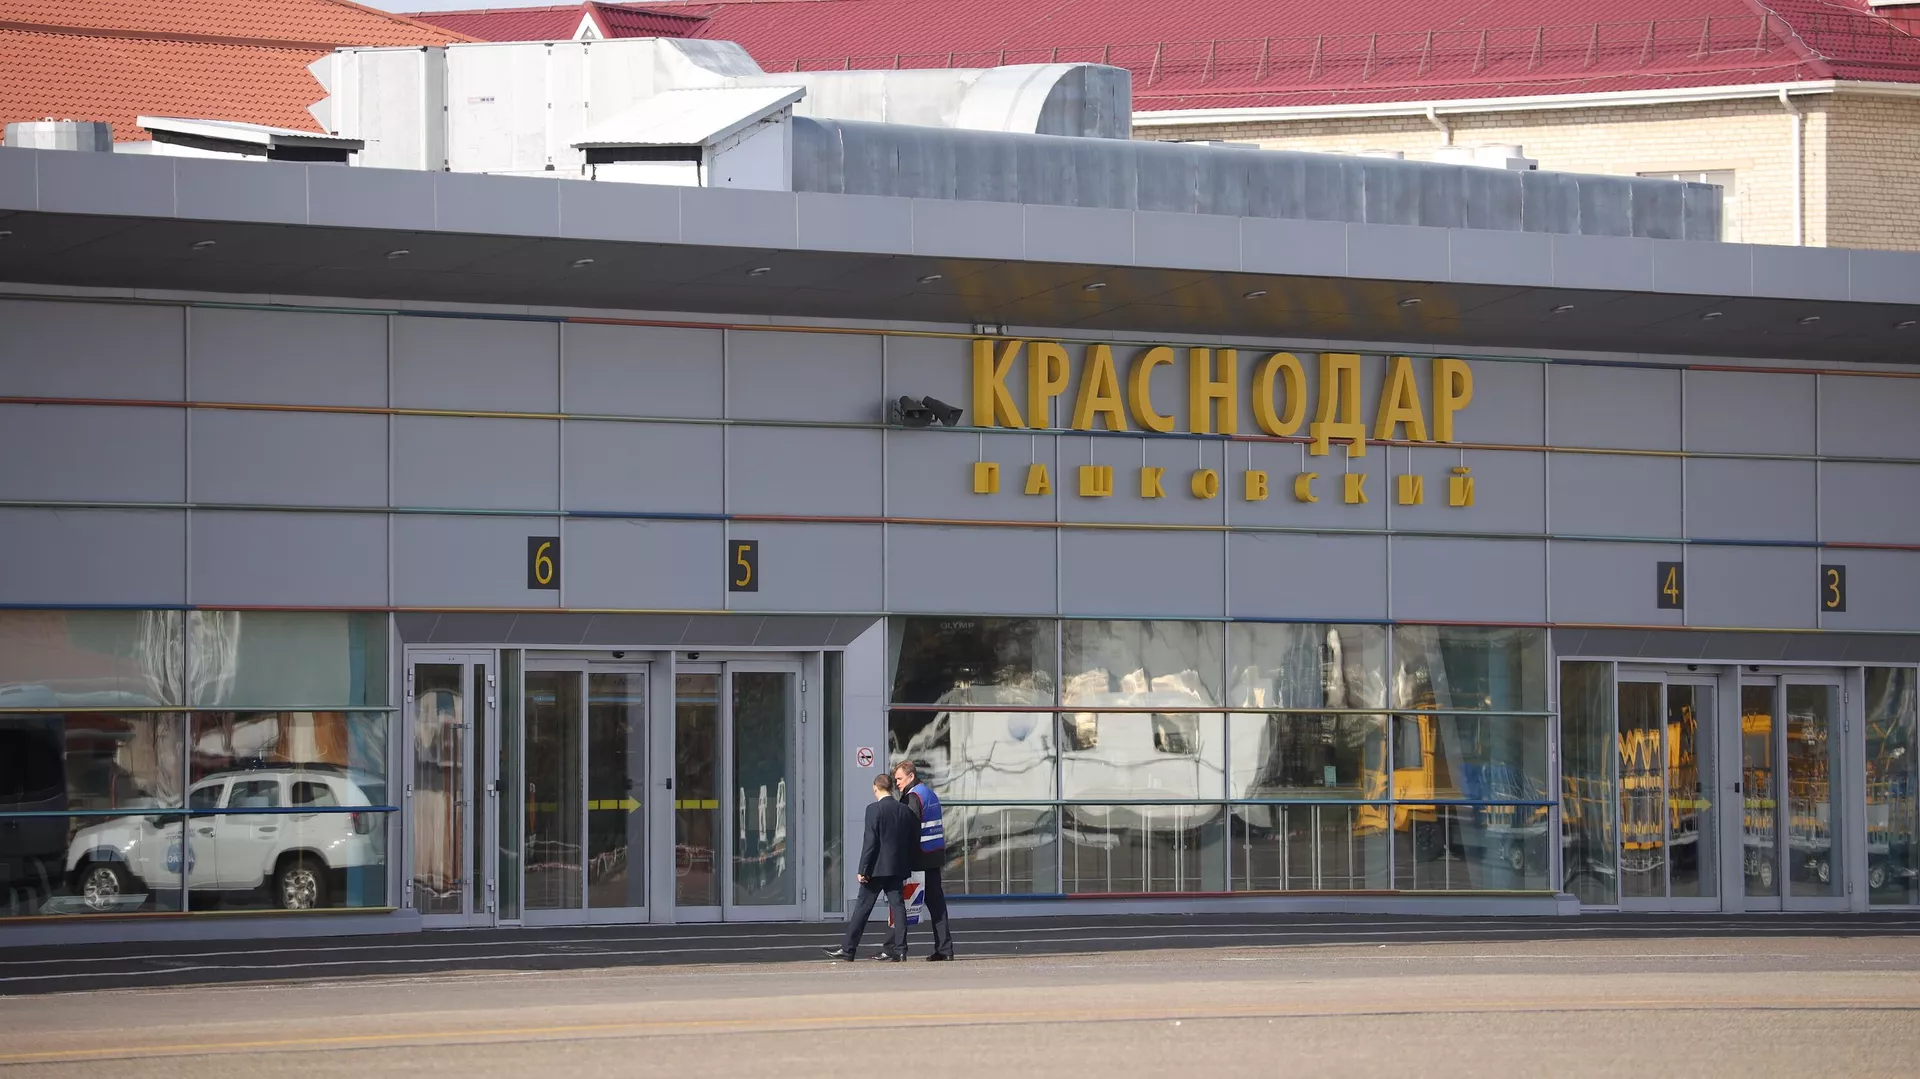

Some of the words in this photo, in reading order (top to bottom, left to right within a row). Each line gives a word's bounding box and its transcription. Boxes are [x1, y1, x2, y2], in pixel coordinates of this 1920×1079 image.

[973, 339, 1473, 458] КРАСНОДАР
[973, 463, 1474, 507] ПАШКОВСКИЙ
[535, 541, 553, 585] 6
[735, 544, 752, 587] 5
[1662, 566, 1678, 604] 4
[1826, 569, 1840, 608] 3
